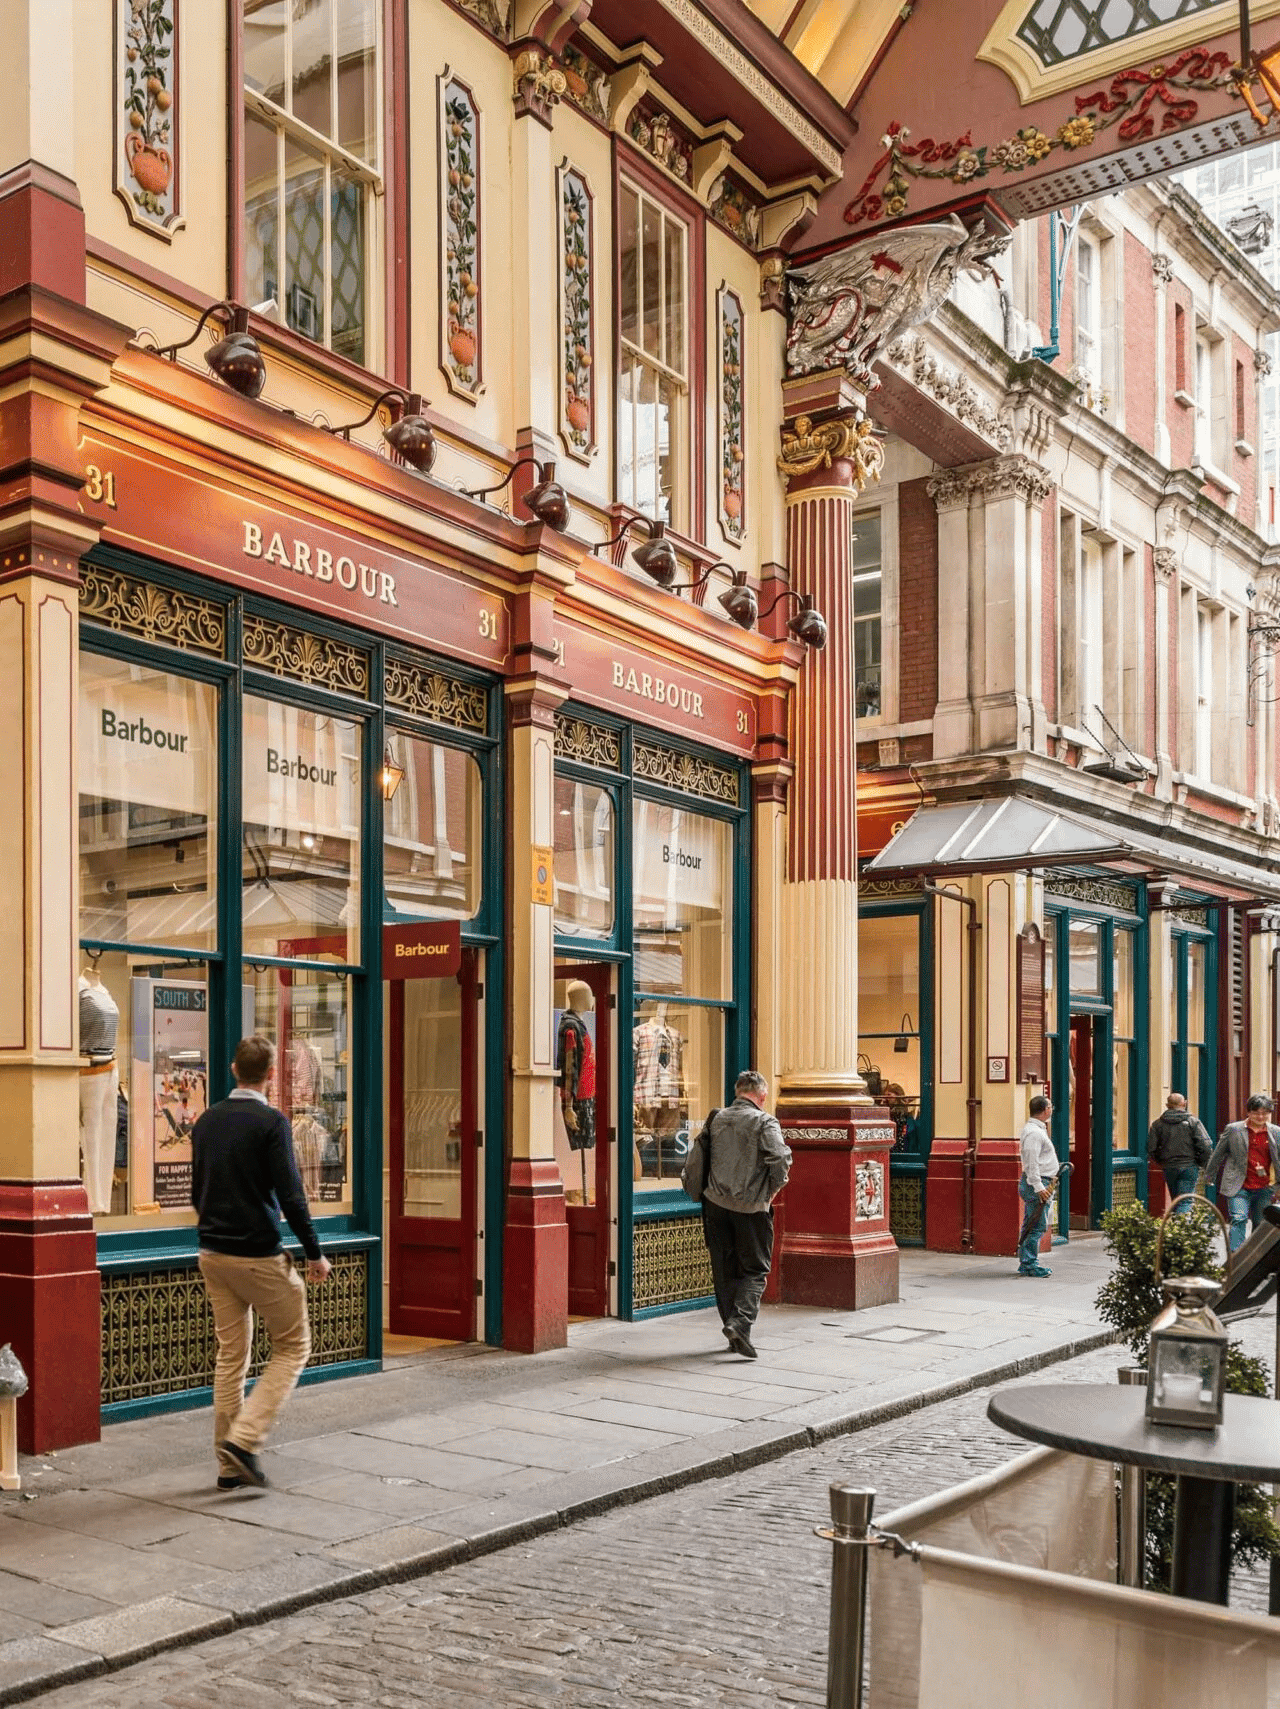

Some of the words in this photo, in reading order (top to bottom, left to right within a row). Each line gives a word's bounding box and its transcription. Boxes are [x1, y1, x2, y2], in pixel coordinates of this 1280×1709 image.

[85, 464, 116, 507] 31
[242, 520, 398, 606] BARBOUR
[478, 608, 498, 641] 31
[613, 660, 704, 718] BARBOUR
[101, 708, 188, 753] Barbour
[736, 709, 749, 735] 31
[267, 747, 337, 787] Barbour
[663, 844, 702, 870] Barbour
[395, 942, 450, 957] Barbour
[154, 987, 189, 1008] SOUTH
[158, 1165, 169, 1174] FOR
